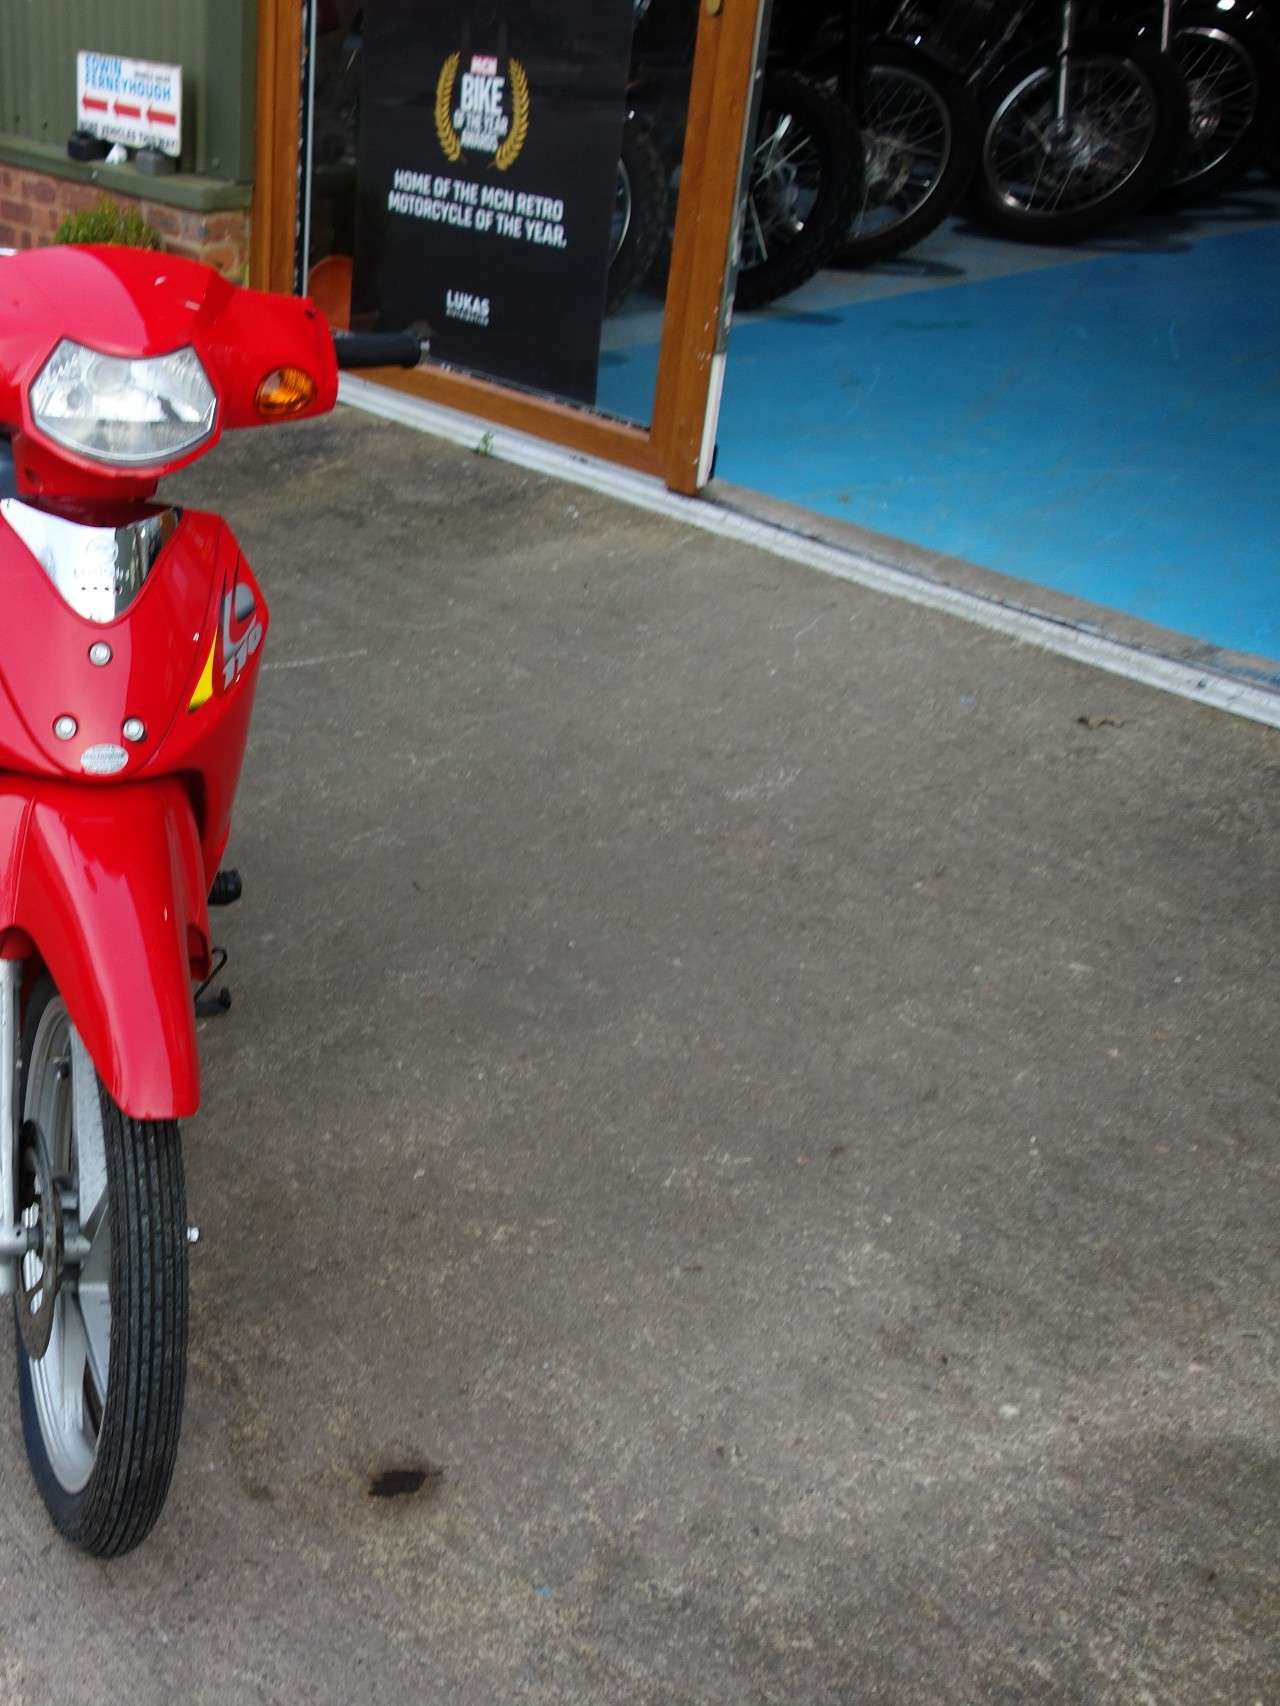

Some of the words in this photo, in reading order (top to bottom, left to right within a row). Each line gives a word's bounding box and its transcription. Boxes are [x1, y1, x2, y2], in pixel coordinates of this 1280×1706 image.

[85, 54, 122, 80] EDWIN
[461, 73, 505, 114] BIKE
[388, 190, 473, 228] MOTORCYCLE
[475, 208, 494, 231] OF
[496, 212, 522, 238] THE
[394, 168, 432, 195] HOME
[433, 176, 451, 199] OF
[453, 179, 479, 205] THE
[481, 185, 514, 212] MCN
[516, 192, 564, 222] RETRO
[447, 289, 489, 317] LUKAS
